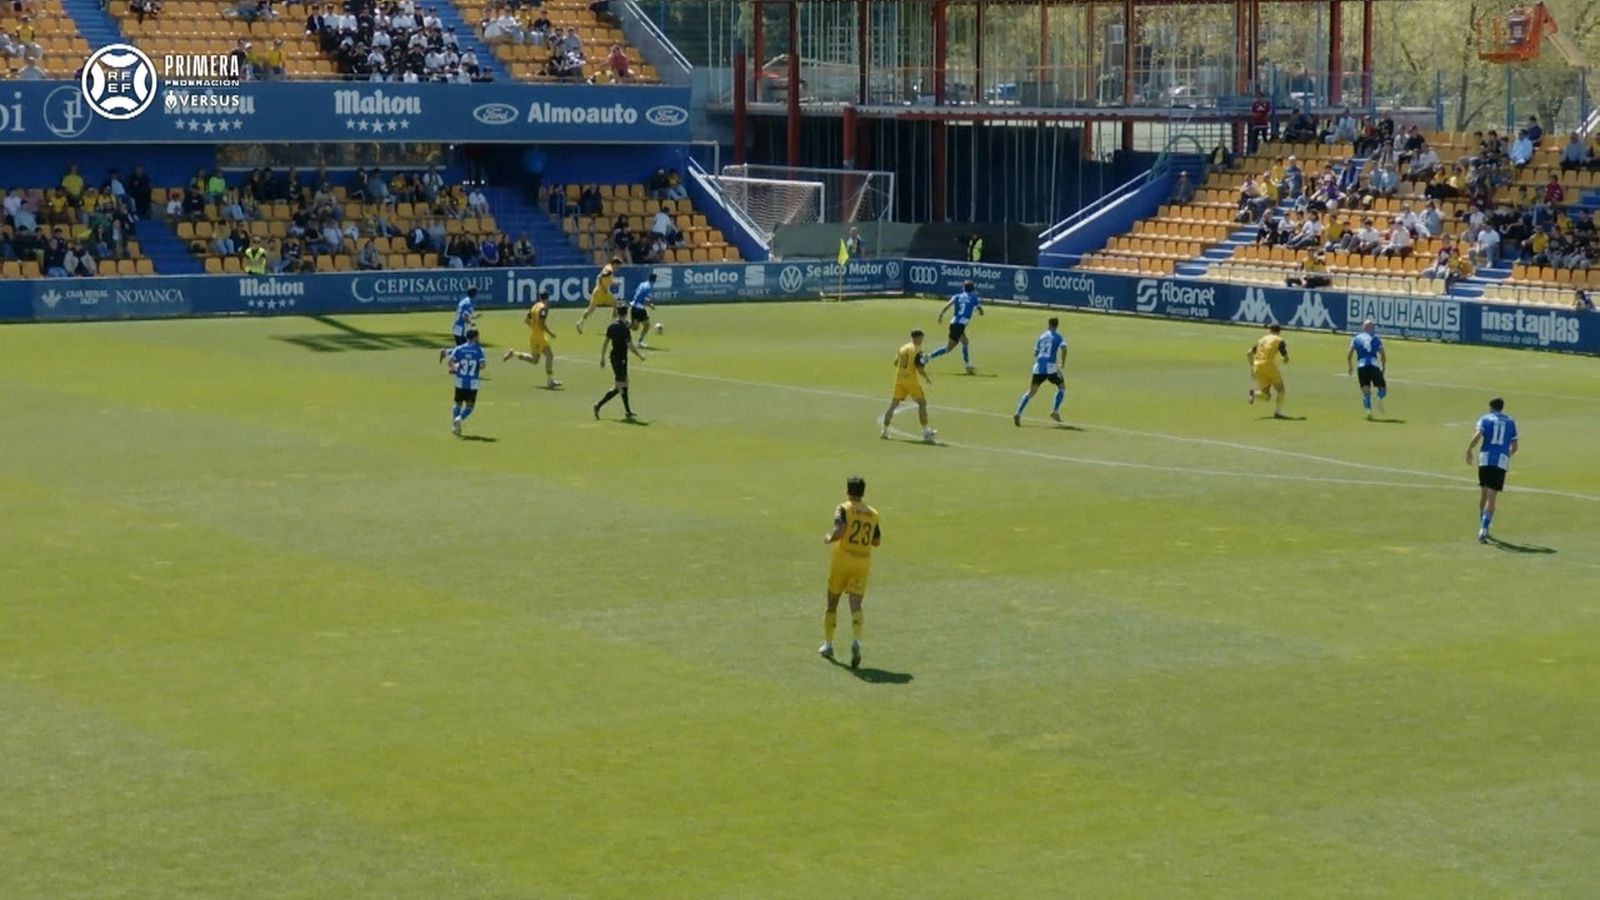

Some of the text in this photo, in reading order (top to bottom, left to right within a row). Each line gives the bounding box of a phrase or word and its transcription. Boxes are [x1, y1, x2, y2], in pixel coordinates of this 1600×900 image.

[334, 89, 422, 114] Mahou
[528, 102, 637, 124] Almoauto
[684, 268, 738, 284] Sealco
[849, 262, 883, 275] Motor
[941, 265, 1001, 280] Sealco Motor
[116, 289, 184, 302] NOVANCA
[239, 277, 304, 296] Mahou
[374, 277, 493, 293] CEPISAGROUP
[1043, 272, 1095, 297] alcorcón
[1160, 282, 1215, 306] fibranet
[1350, 299, 1458, 326] BAUHAUS
[1481, 306, 1580, 346] instaglas
[459, 359, 478, 376] 37
[1491, 421, 1507, 445] 11
[849, 520, 871, 546] 23
